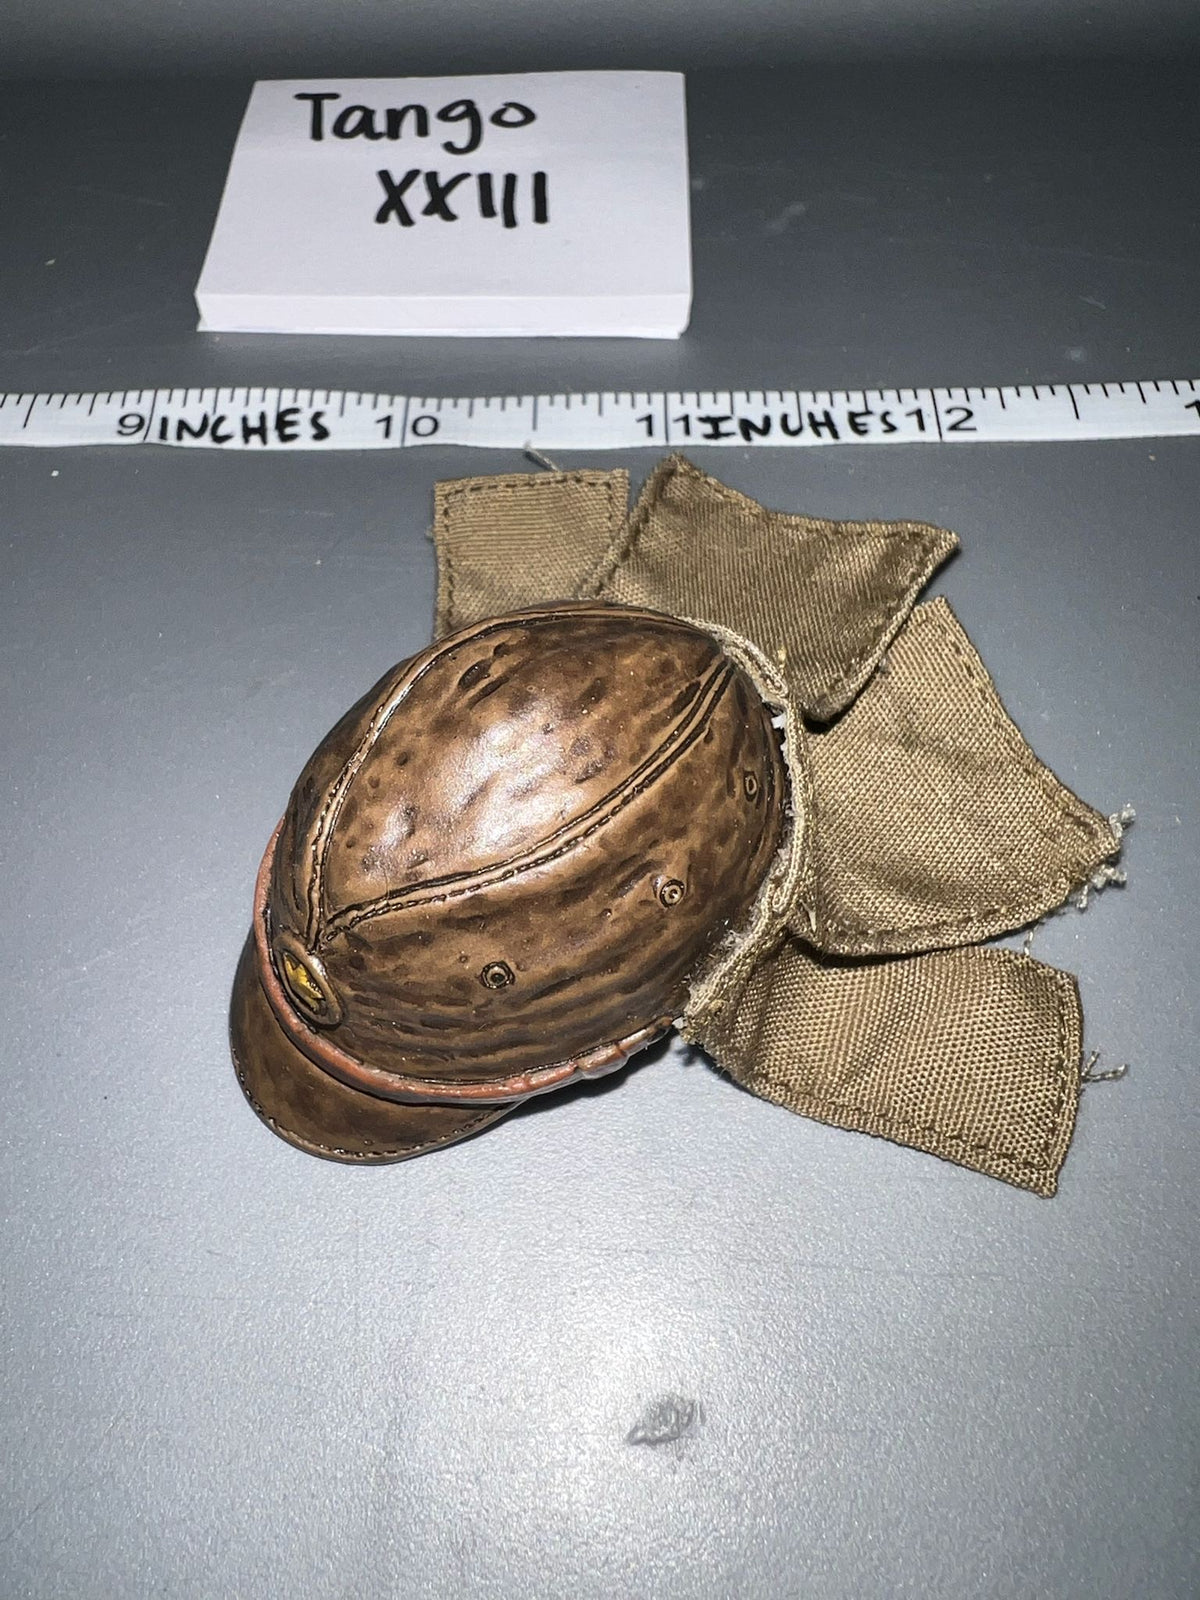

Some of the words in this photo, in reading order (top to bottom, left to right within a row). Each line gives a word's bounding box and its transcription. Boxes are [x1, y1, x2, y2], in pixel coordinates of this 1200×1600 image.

[294, 92, 537, 155] Tango
[374, 169, 549, 228] XXIII
[116, 413, 146, 437] 9
[158, 408, 331, 445] INCHES
[375, 415, 440, 440] 10
[905, 407, 977, 433] 12
